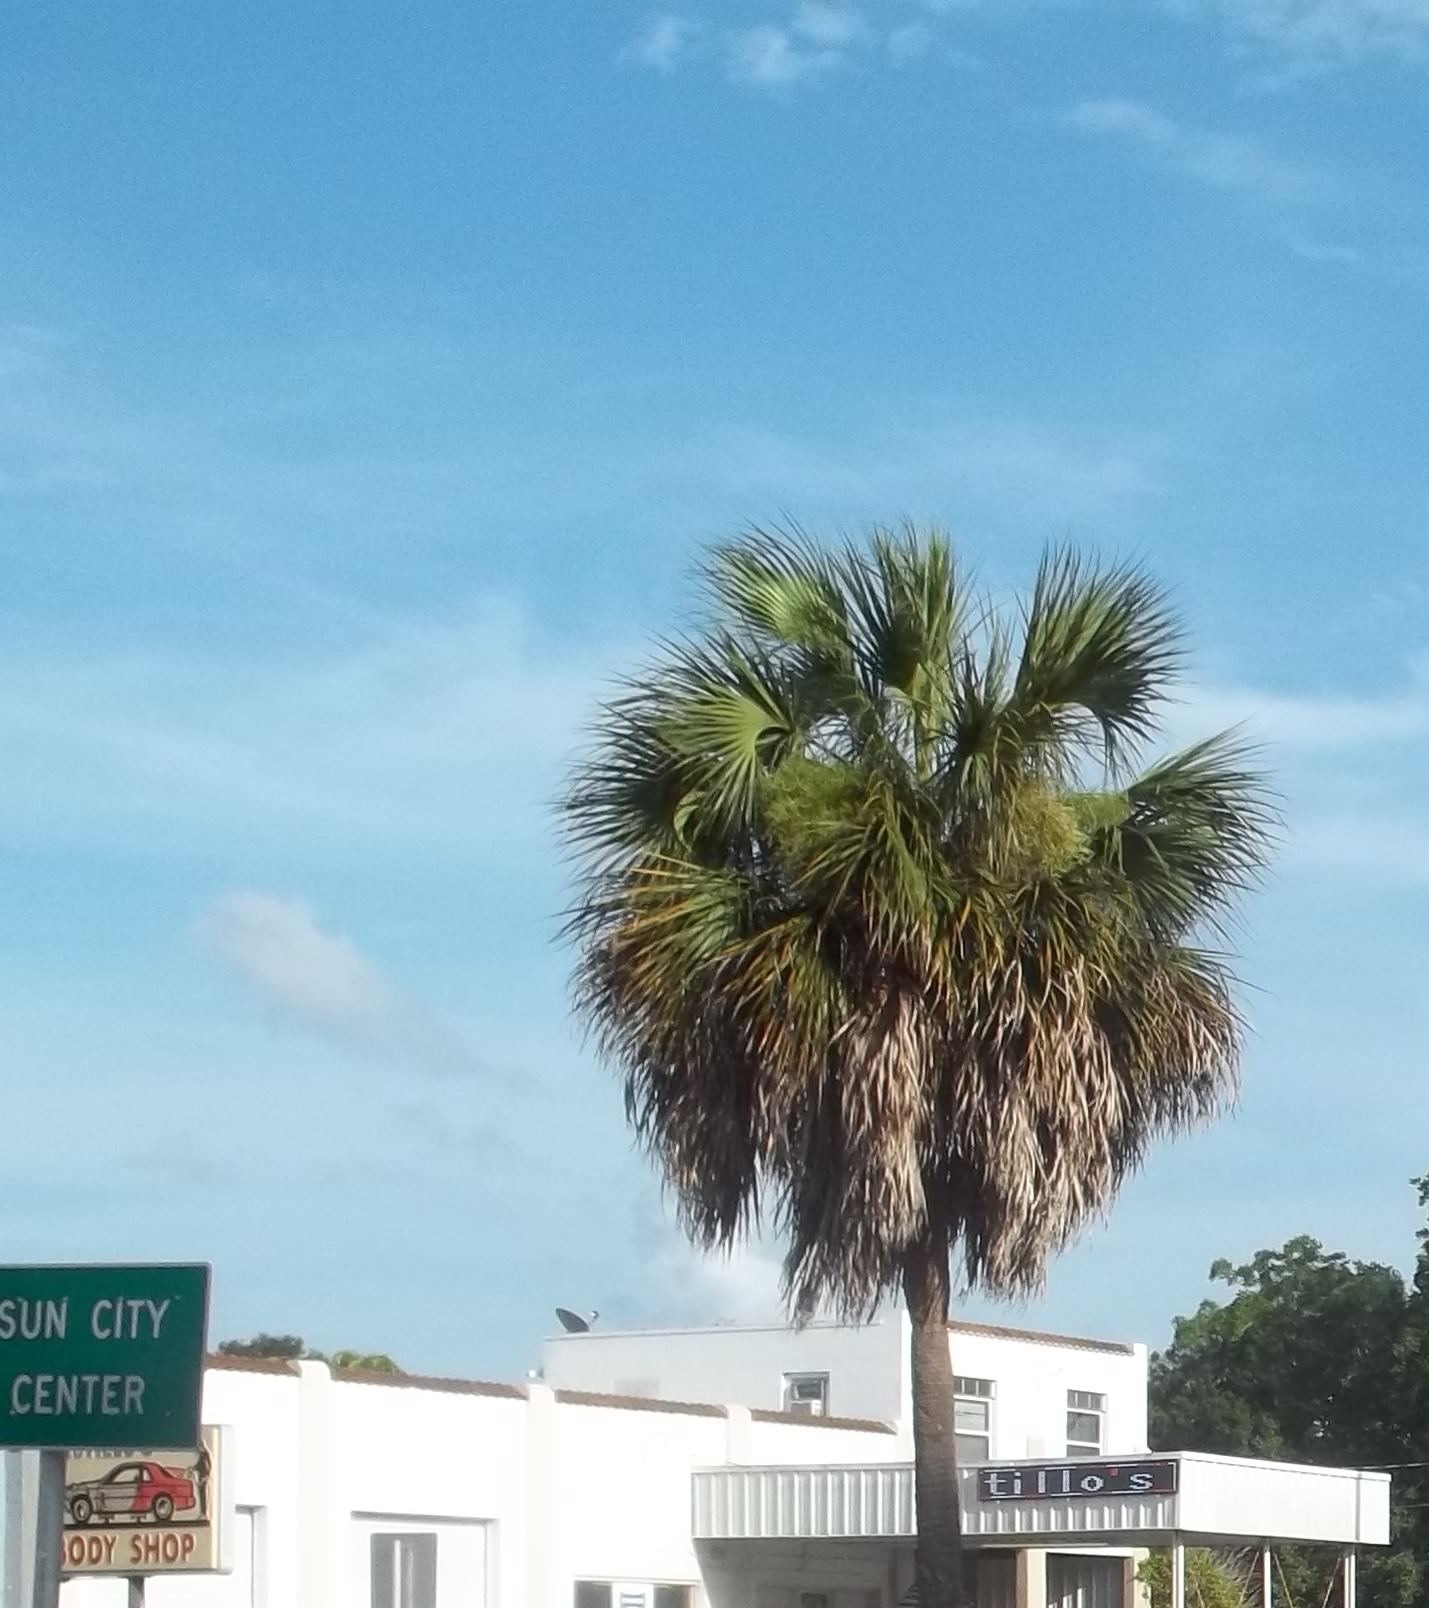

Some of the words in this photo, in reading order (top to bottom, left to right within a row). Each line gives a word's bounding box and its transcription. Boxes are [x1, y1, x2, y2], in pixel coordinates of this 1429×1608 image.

[0, 1299, 67, 1340] SUN
[91, 1298, 171, 1340] CITY
[12, 1373, 146, 1416] CENTER
[130, 1532, 195, 1564] SHOP
